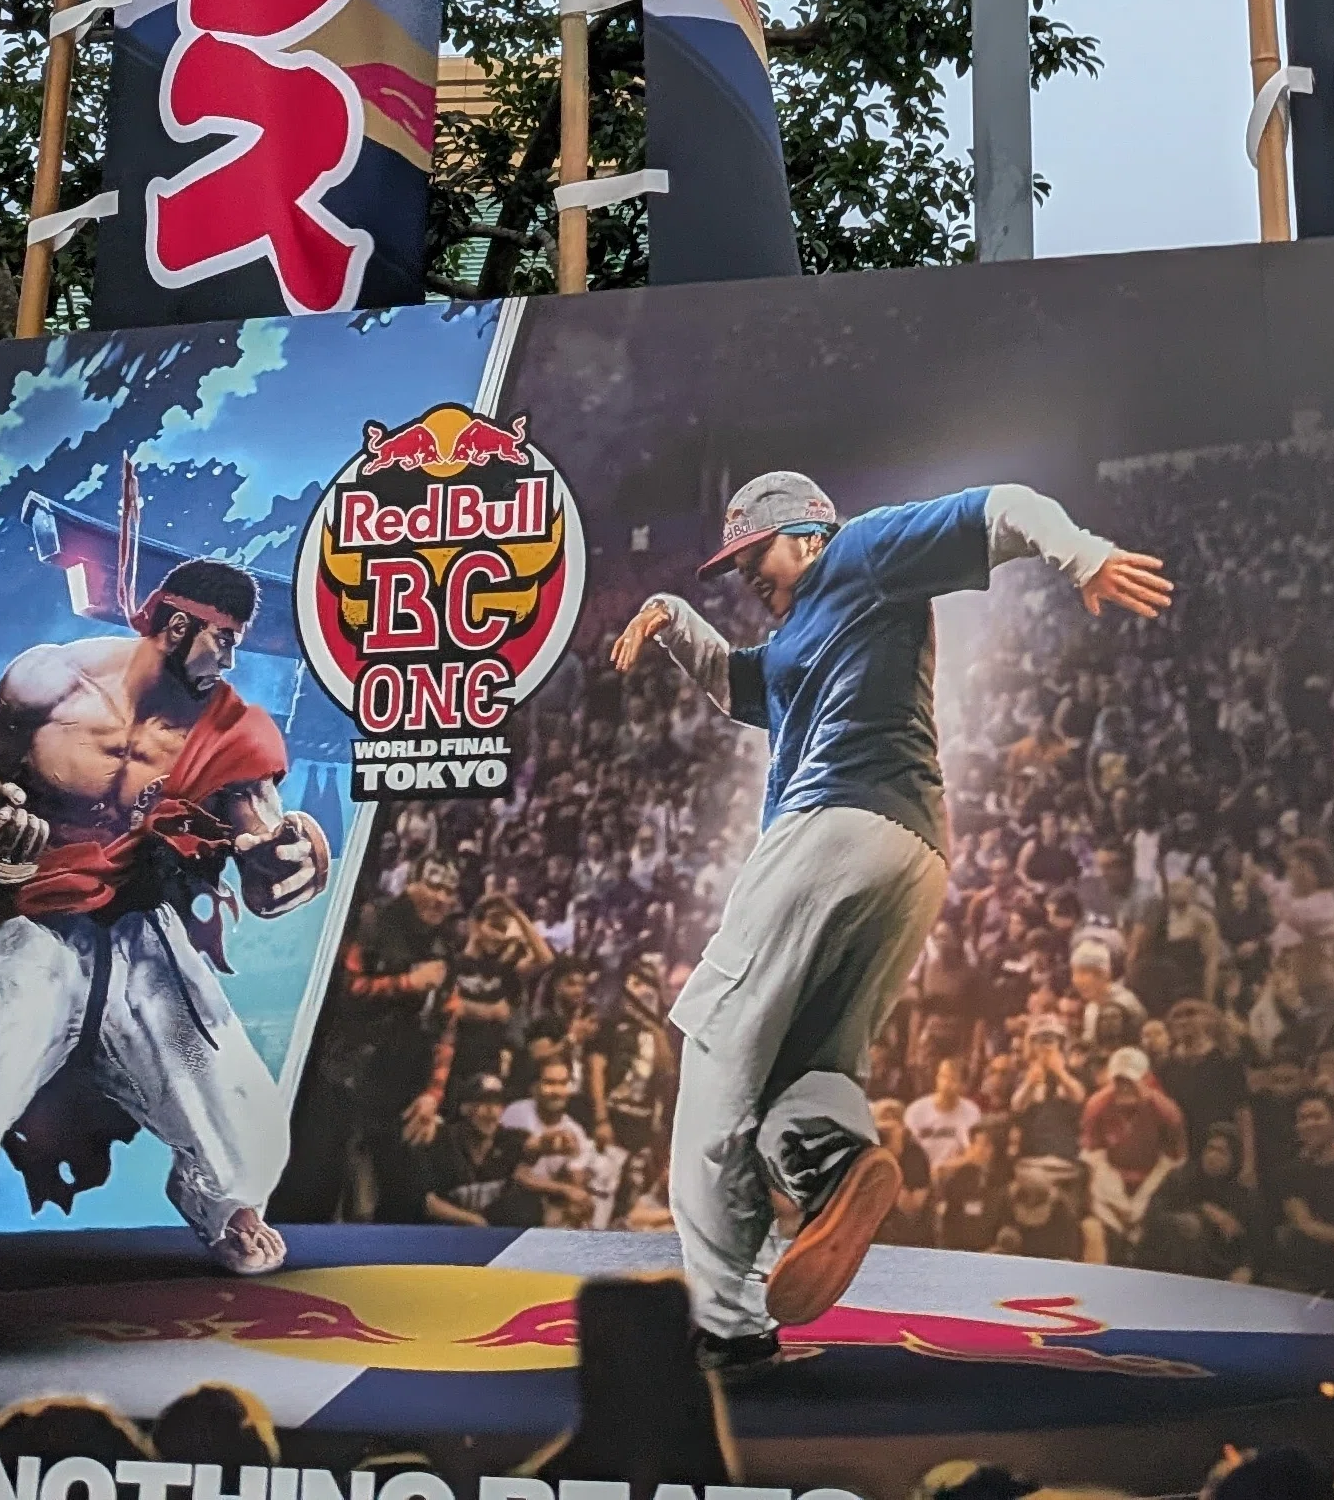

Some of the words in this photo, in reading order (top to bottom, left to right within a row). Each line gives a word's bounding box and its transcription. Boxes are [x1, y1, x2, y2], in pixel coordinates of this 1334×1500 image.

[339, 483, 444, 547] Red
[445, 477, 548, 541] Bull
[362, 551, 512, 654] BC
[358, 659, 510, 734] ONE
[353, 739, 439, 759] WORLD
[439, 736, 511, 756] FINAL
[356, 759, 508, 792] TOKYO
